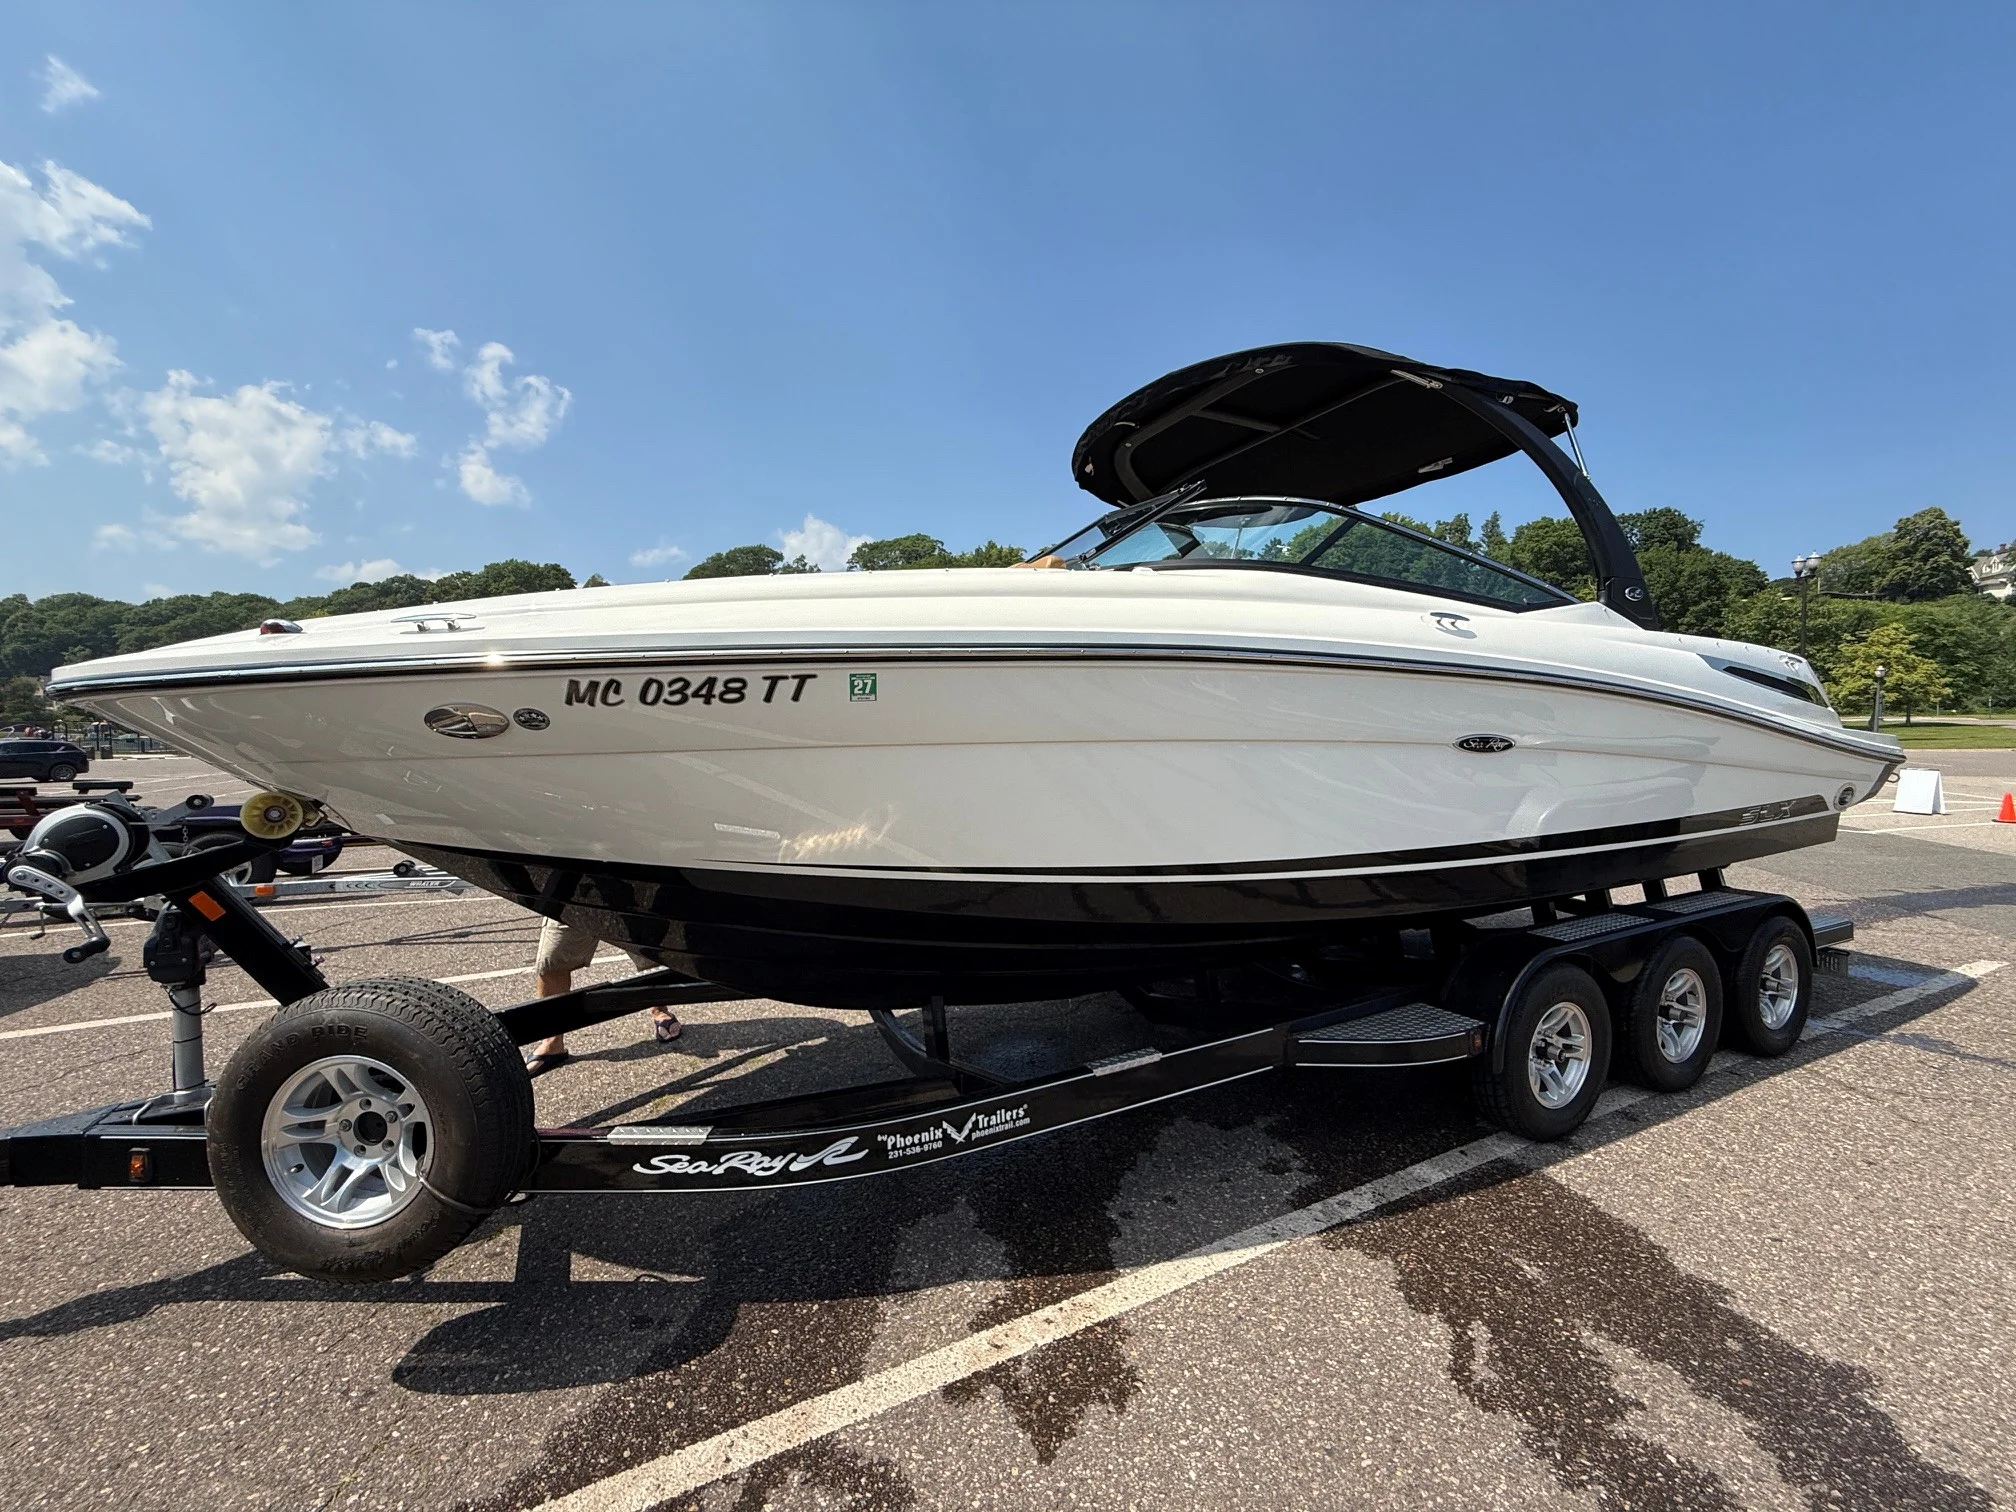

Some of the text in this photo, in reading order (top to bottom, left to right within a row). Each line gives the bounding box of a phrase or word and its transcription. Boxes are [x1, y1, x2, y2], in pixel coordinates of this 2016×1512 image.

[564, 673, 818, 707] MC 0348 TT
[853, 679, 872, 694] 27
[235, 1023, 368, 1090] GRAND RIDE
[887, 1126, 943, 1150] Phoenix
[977, 1107, 1026, 1129] Trailers
[971, 1117, 1031, 1142] phoenixtrail.com
[632, 1150, 798, 1176] Sea Ray
[888, 1141, 943, 1159] 231-536-9760
